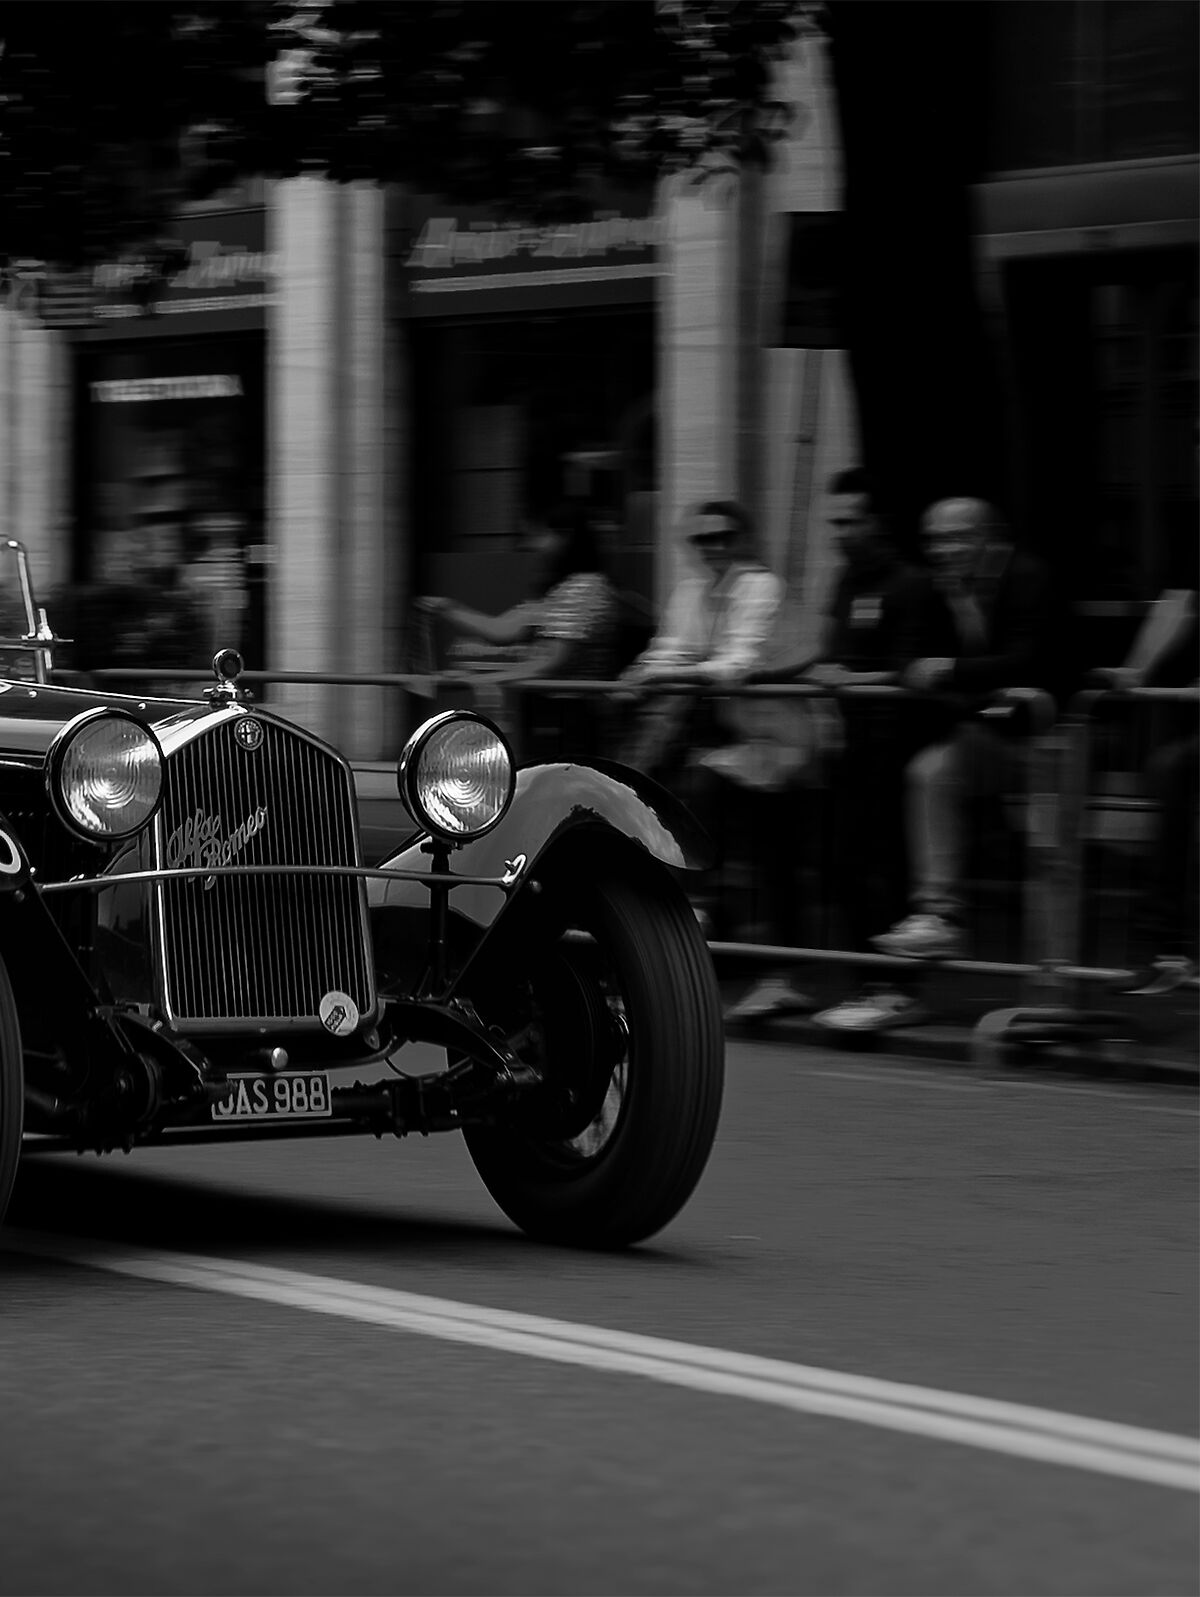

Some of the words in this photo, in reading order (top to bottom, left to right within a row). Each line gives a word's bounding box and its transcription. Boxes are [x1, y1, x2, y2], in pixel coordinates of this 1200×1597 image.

[166, 808, 220, 883] Alfa
[201, 806, 268, 891] Romeo
[273, 1077, 326, 1113] 988
